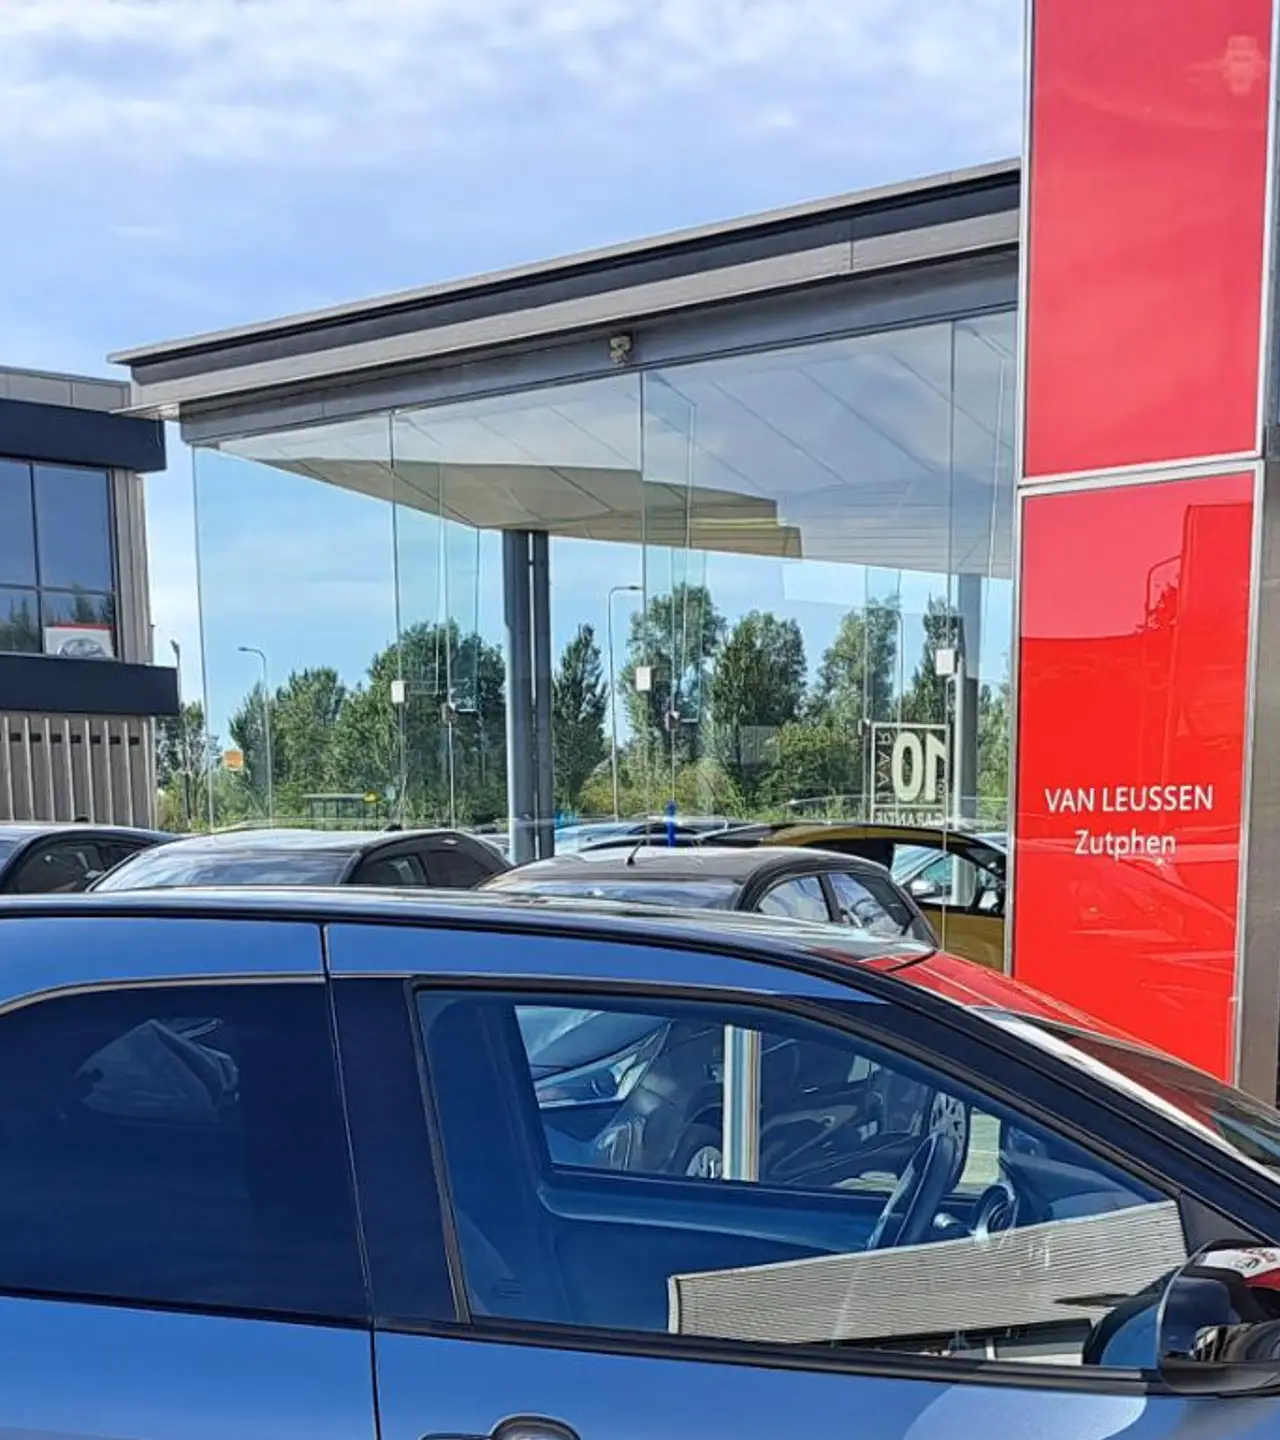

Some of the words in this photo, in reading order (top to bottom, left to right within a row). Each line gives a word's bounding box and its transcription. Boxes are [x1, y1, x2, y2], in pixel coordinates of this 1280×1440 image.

[1044, 787, 1095, 813] VAN
[1102, 785, 1213, 812] LEUSSEN
[1074, 828, 1176, 860] Zutphen
